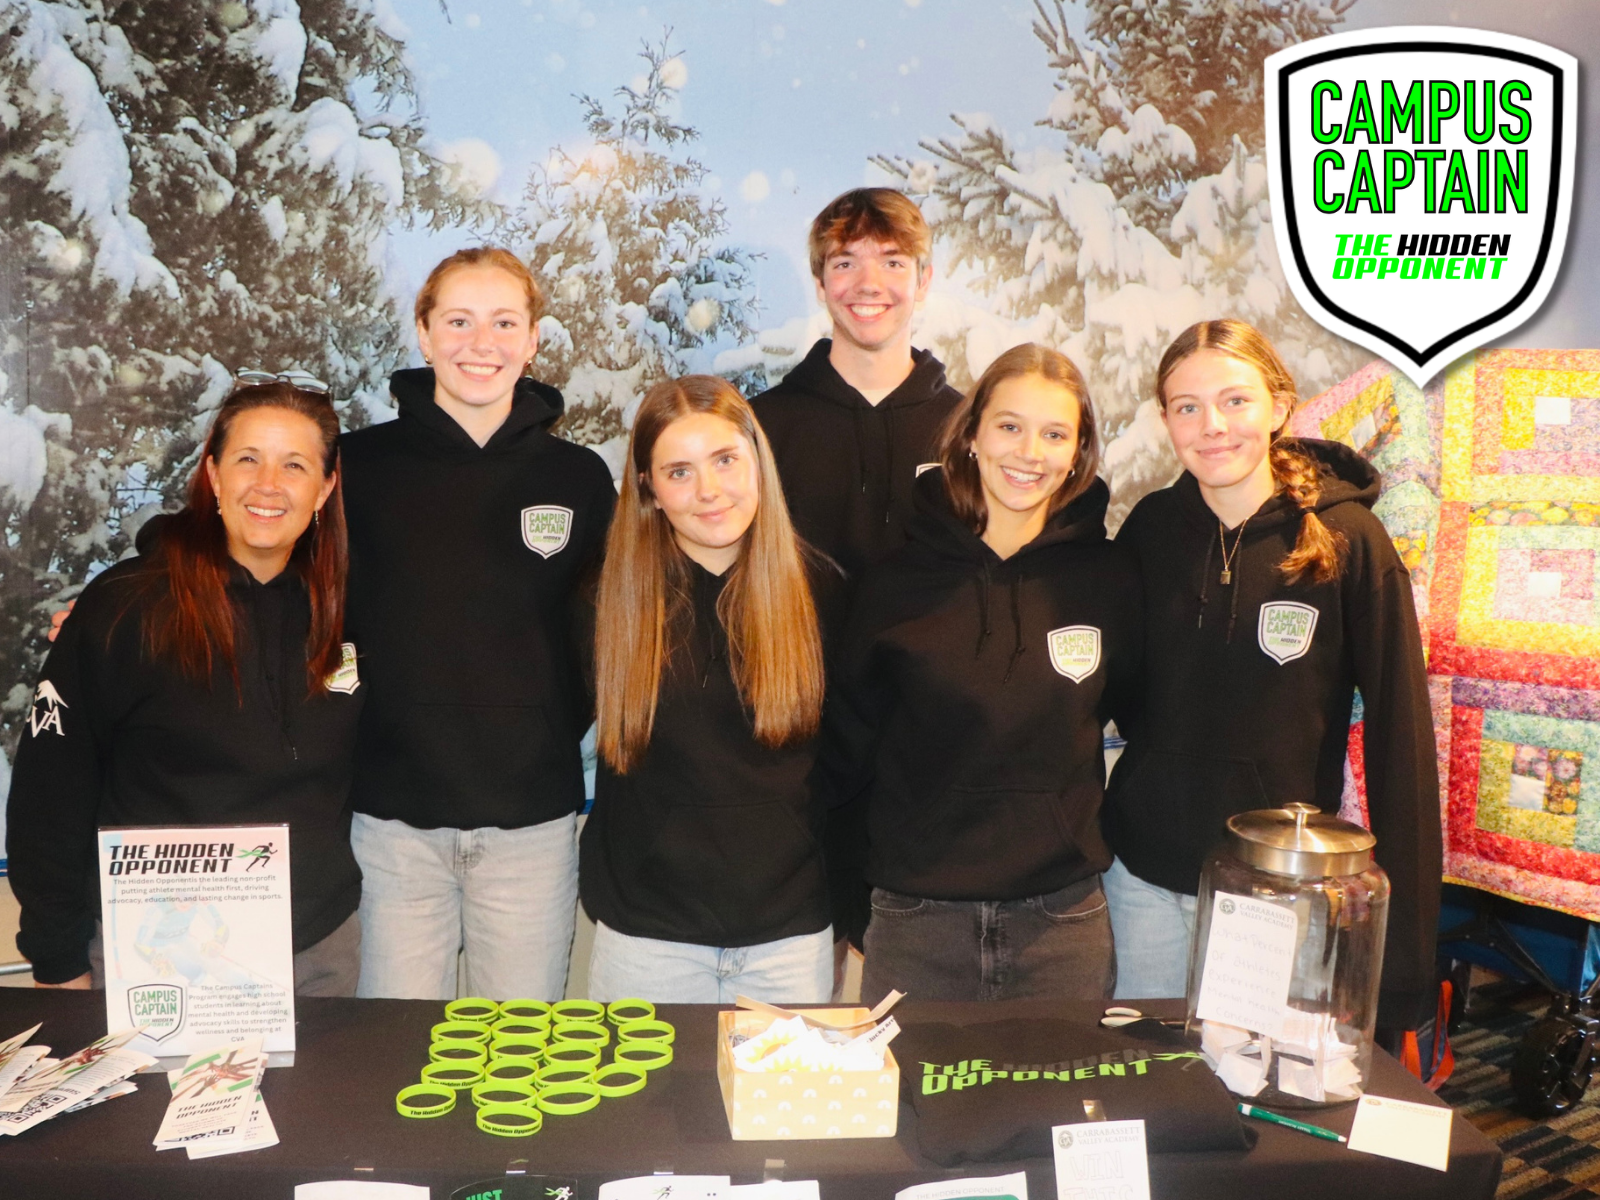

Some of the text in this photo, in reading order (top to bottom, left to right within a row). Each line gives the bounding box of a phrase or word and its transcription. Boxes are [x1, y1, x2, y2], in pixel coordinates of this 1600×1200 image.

[529, 513, 566, 524] CAMPUS
[529, 523, 565, 534] CAPTAIN
[1268, 609, 1310, 624] CAMPUS
[1266, 621, 1307, 637] CAPTAIN
[1055, 633, 1094, 646] CAMPUS
[1057, 645, 1094, 656] CAPTAIN
[109, 843, 235, 860] THE HIDDEN
[108, 858, 233, 876] OPPONENT
[128, 877, 155, 885] Hidden
[212, 875, 239, 885] leading
[239, 874, 277, 884] non-profit
[121, 886, 148, 896] putting
[148, 886, 174, 894] athlete
[175, 885, 201, 893] mental
[202, 884, 225, 892] health
[244, 883, 270, 893] driving
[183, 894, 199, 902] and
[199, 894, 223, 904] lasting
[224, 893, 250, 902] change
[1240, 902, 1295, 924] CARRABASSETT
[1240, 910, 1294, 930] VALLEY ACADEMY
[214, 984, 242, 992] Campus
[243, 982, 273, 991] Captains
[133, 990, 177, 1003] CAMPUS
[134, 1003, 177, 1016] CAPTAIN
[250, 1008, 288, 1016] developing
[190, 1020, 222, 1028] advocacy
[223, 1018, 241, 1026] skills
[250, 1017, 287, 1025] strengthen
[195, 1028, 225, 1036] wellness
[240, 1026, 274, 1035] belonging
[919, 1059, 993, 1076] THE
[921, 1058, 1152, 1095] OPPONENT
[1077, 1126, 1140, 1138] CARRABASSETT
[1078, 1138, 1102, 1146] VALLEY
[1104, 1135, 1139, 1143] ACADEMY
[1069, 1151, 1125, 1181] WIN
[932, 1189, 961, 1198] HIDDEN
[962, 1186, 1005, 1195] OPPONENT
